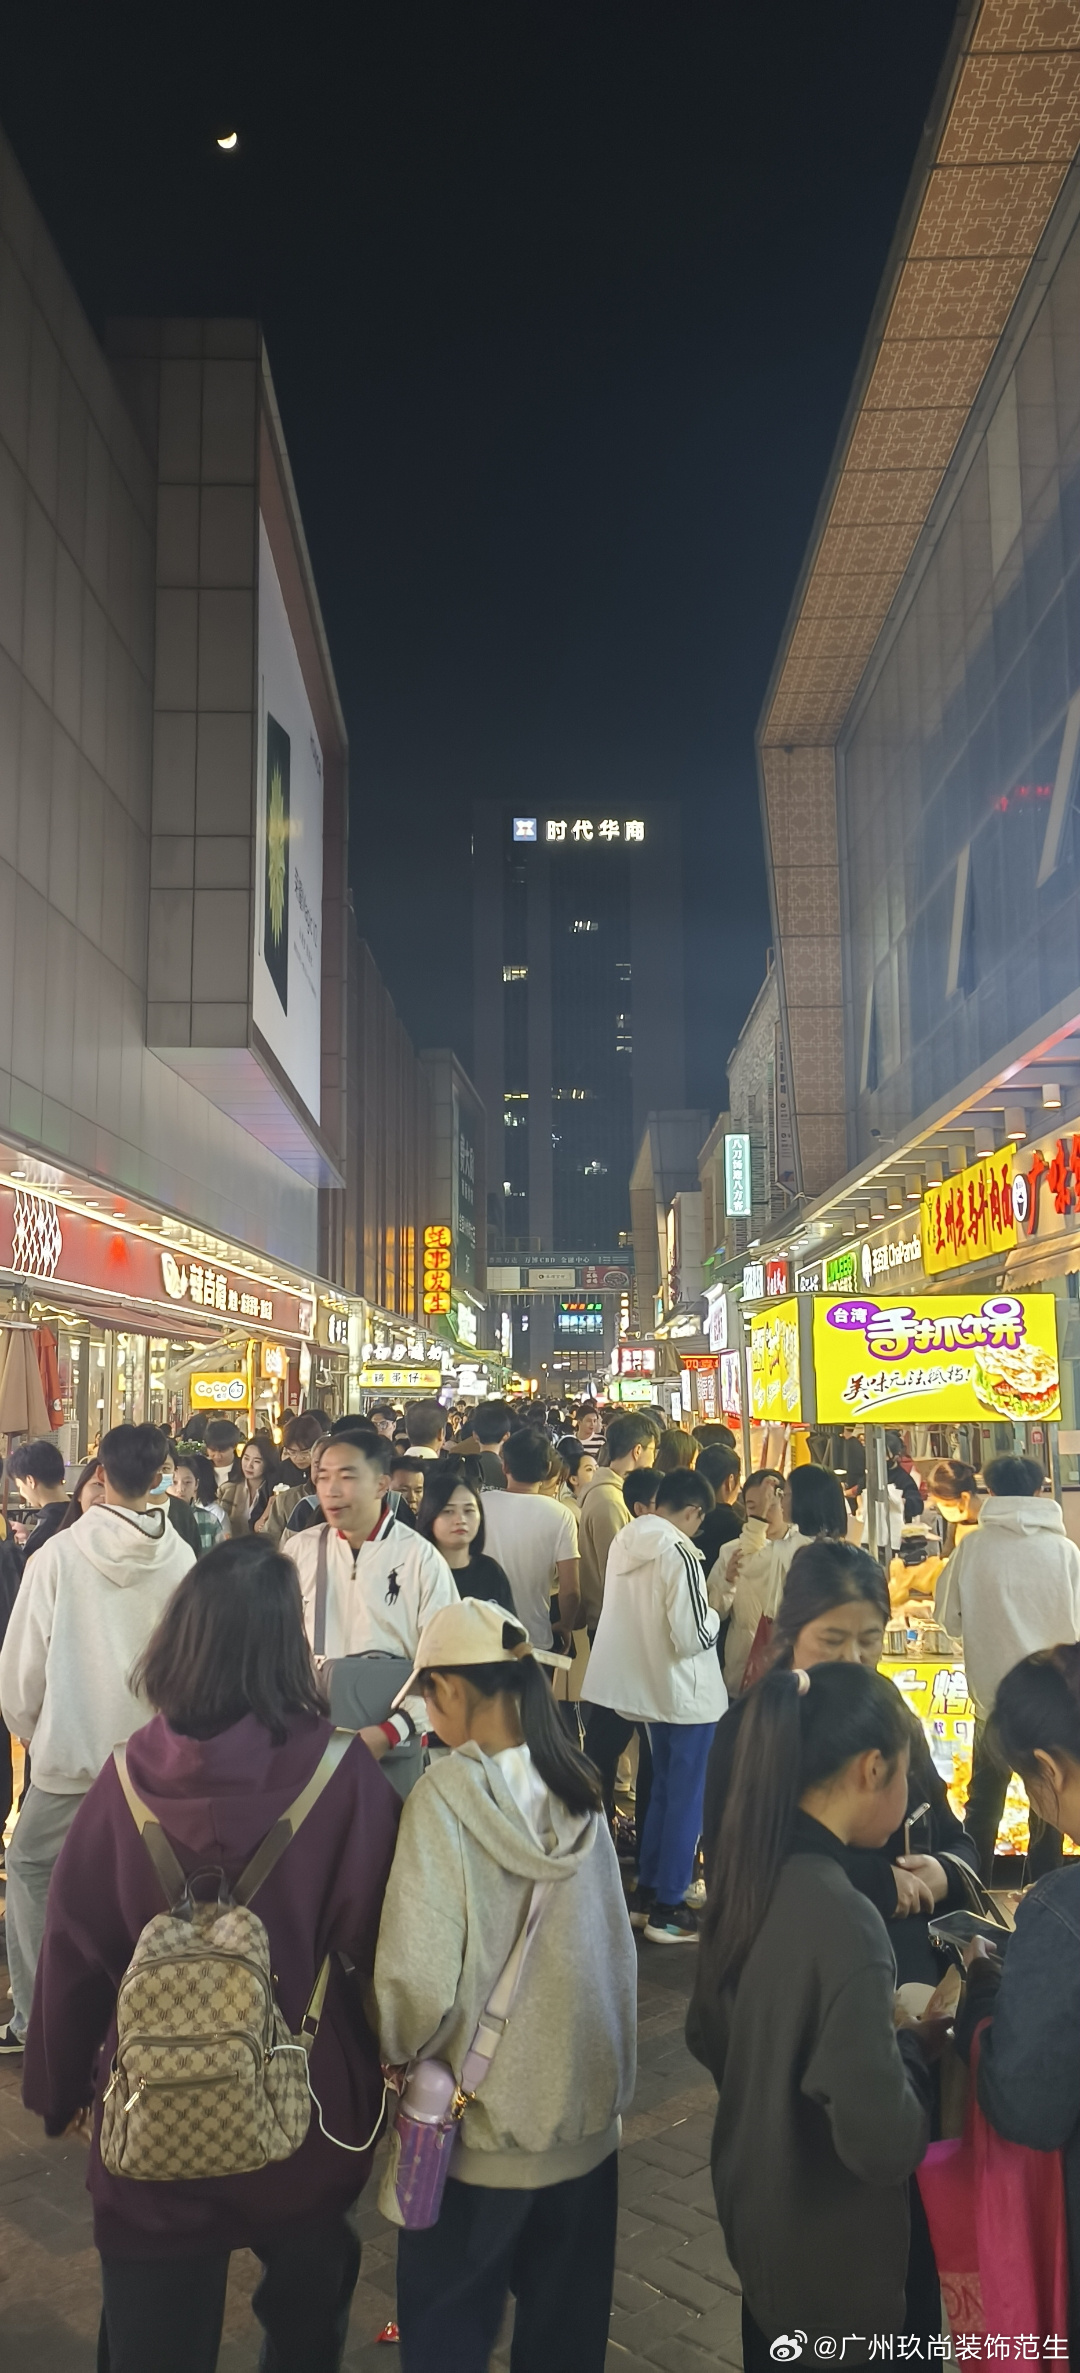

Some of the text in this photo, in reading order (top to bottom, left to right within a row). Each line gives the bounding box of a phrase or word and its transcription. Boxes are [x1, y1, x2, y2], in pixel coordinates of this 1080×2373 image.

[546, 819, 645, 842] 时代华商
[426, 1226, 450, 1314] 蚝事发生
[561, 1256, 590, 1264] 金融中心
[832, 1307, 868, 1325] 台湾
[868, 1299, 1024, 1357] 手抓饼
